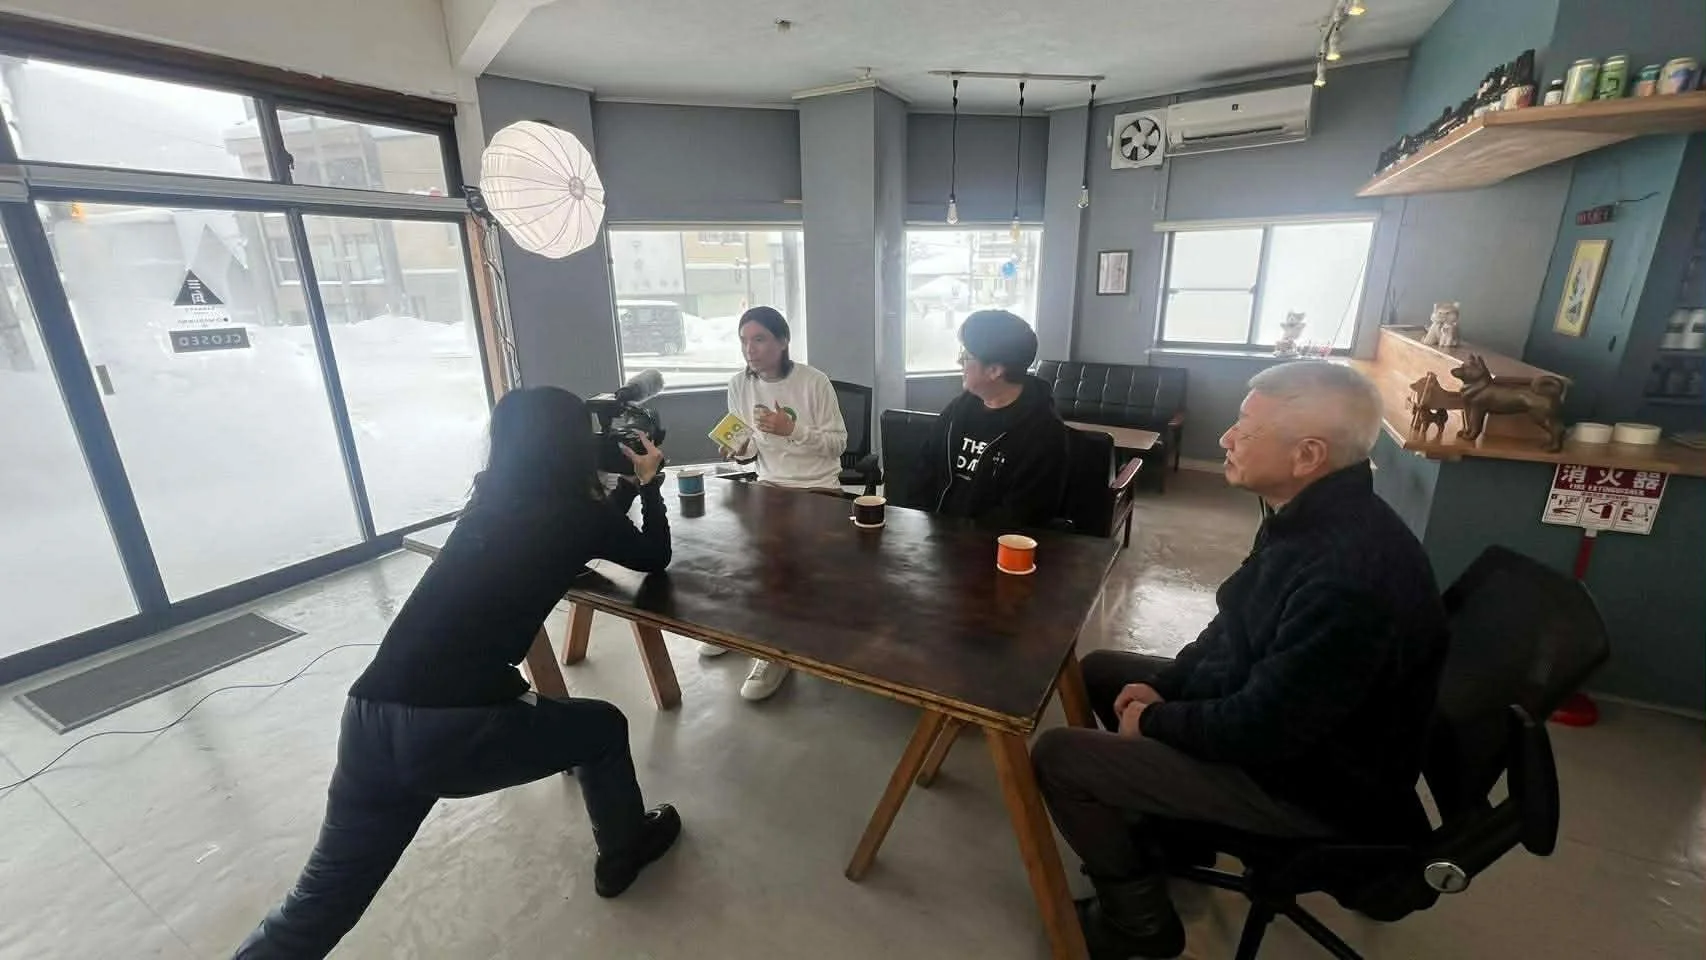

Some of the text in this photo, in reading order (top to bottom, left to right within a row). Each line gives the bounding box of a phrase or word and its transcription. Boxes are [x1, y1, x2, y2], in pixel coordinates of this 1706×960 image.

[962, 437, 988, 454] THE
[1560, 464, 1661, 490] 消火器
